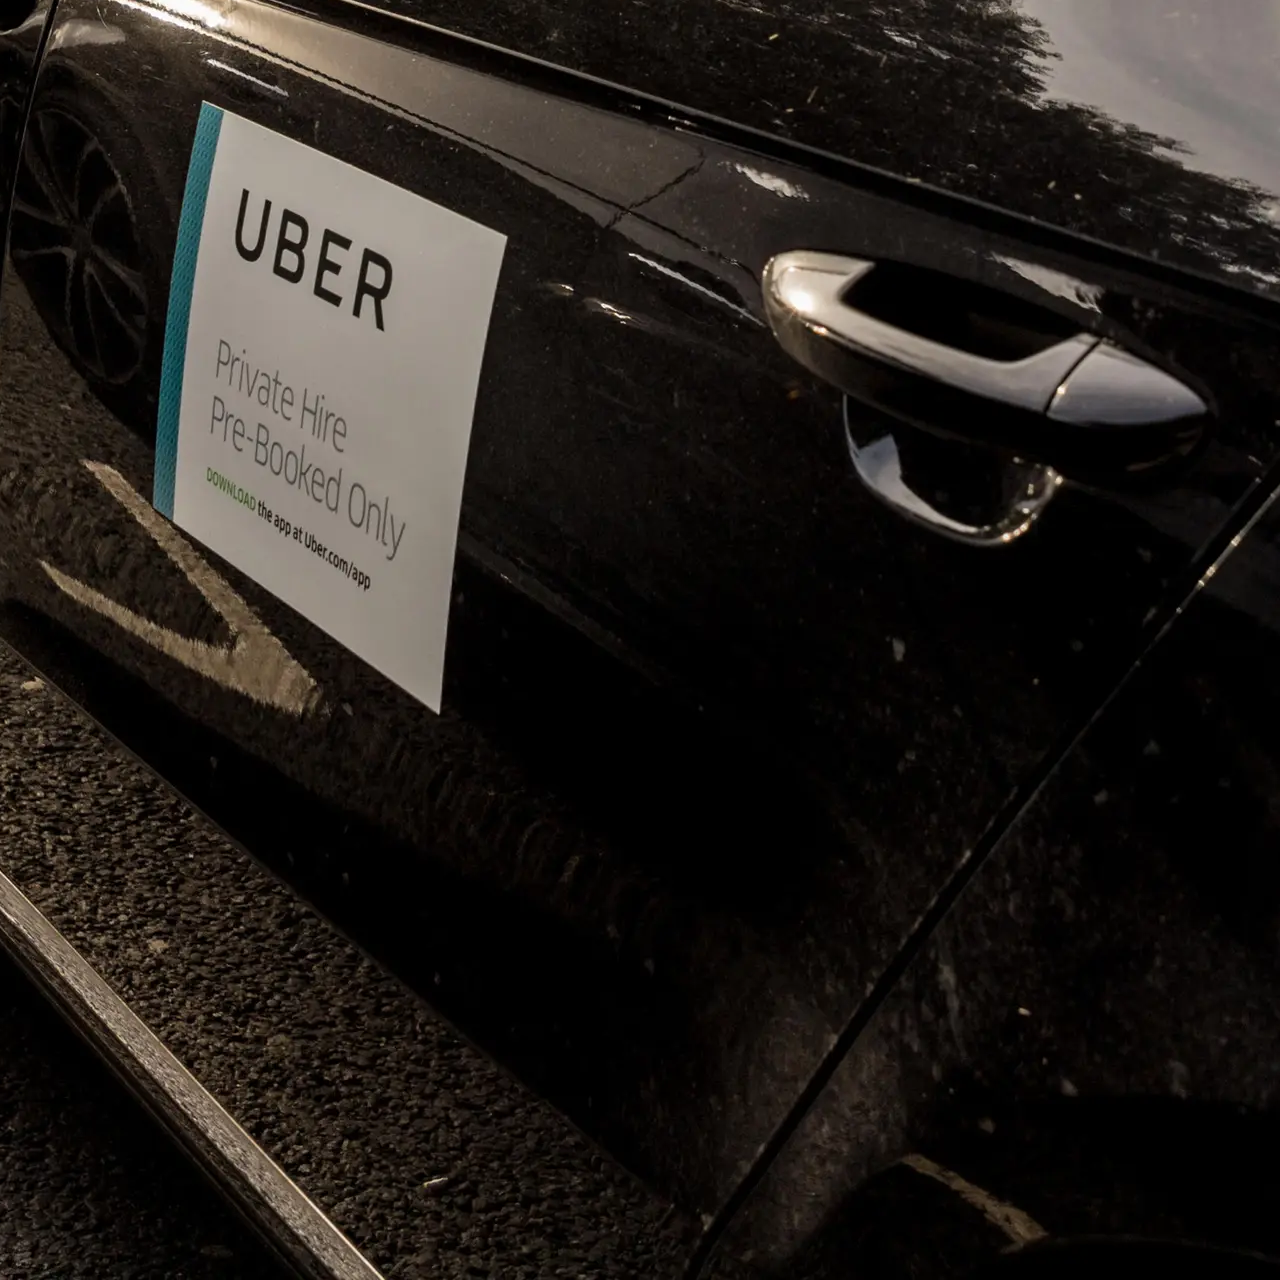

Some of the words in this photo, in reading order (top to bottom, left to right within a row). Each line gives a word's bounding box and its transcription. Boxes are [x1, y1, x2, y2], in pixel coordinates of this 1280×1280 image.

[234, 188, 394, 332] UBER
[216, 339, 295, 421] Private
[300, 387, 347, 453] Hire
[206, 466, 257, 511] DOWNLOAD
[258, 500, 273, 523] the
[273, 514, 291, 537] app
[292, 525, 303, 543] at
[304, 528, 371, 591] Uber.com/app
[211, 395, 342, 514] Pre-Booked
[348, 482, 406, 561] Only
